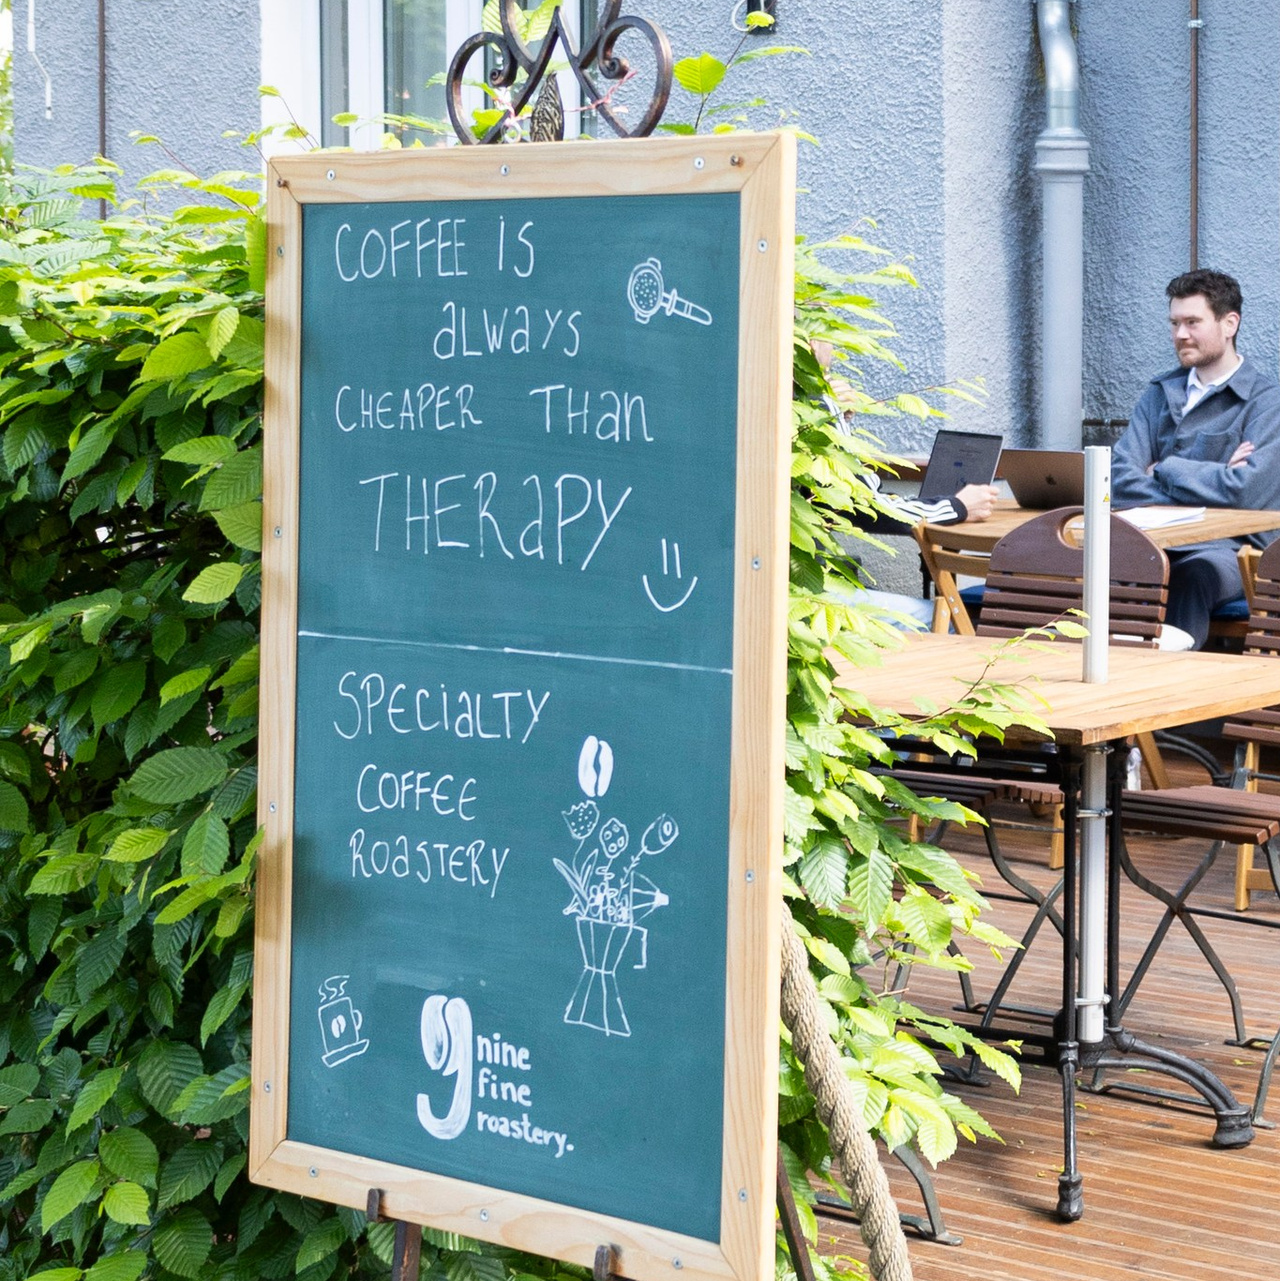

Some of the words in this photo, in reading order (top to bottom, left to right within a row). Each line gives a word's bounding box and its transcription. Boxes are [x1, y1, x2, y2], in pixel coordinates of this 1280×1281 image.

[335, 217, 469, 282] COFFEE
[335, 382, 483, 433] CHEAPER
[356, 763, 478, 822] COFFEE
[476, 1032, 532, 1071] nine
[477, 1066, 533, 1108] fine
[476, 1110, 575, 1159] roastery.
